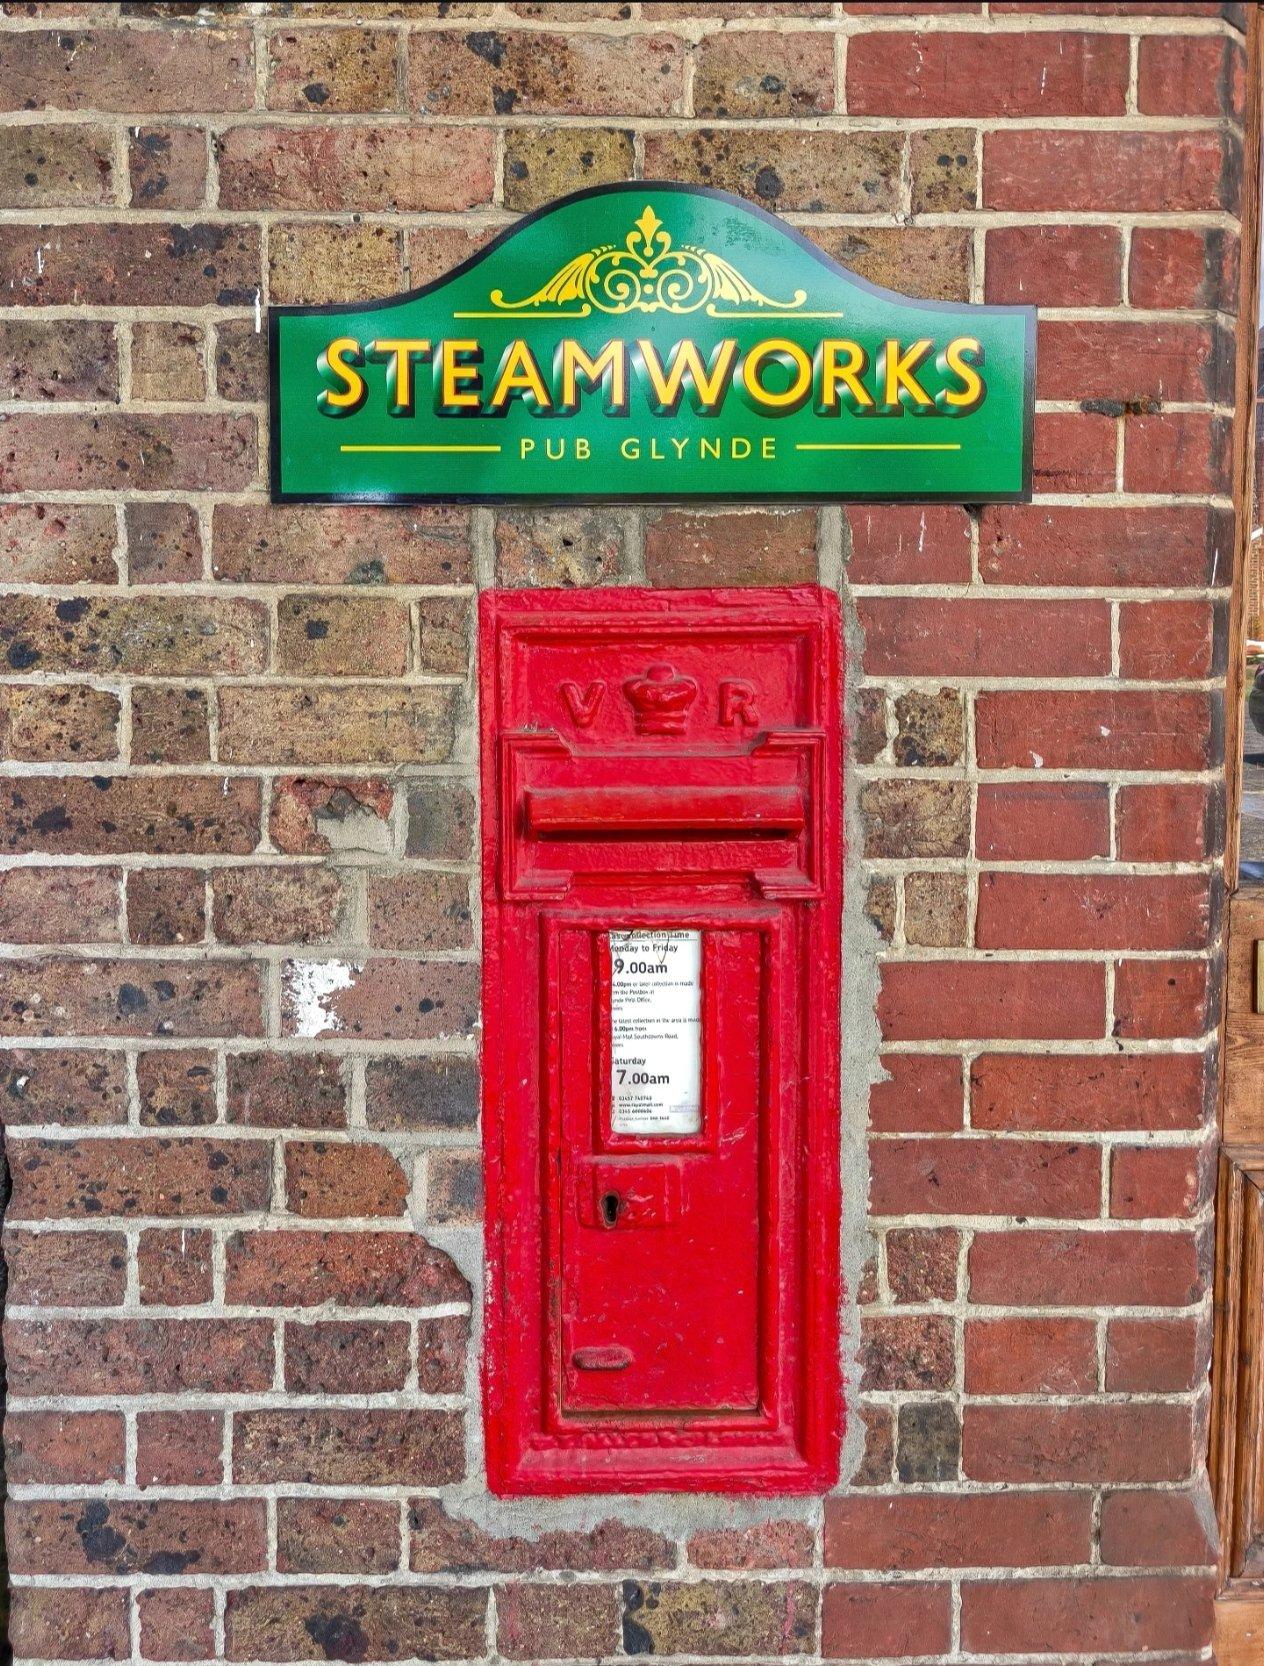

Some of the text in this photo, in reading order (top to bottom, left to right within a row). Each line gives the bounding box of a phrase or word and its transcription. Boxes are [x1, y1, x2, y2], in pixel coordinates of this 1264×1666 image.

[318, 337, 984, 413] STEAMWORKS
[520, 437, 777, 460] PUB GLYNDE
[560, 678, 758, 728] V R
[631, 930, 667, 940] ollection
[641, 944, 650, 952] to
[652, 943, 679, 953] Friday
[613, 958, 668, 975] 9.00am
[615, 1068, 671, 1086] 7.00am
